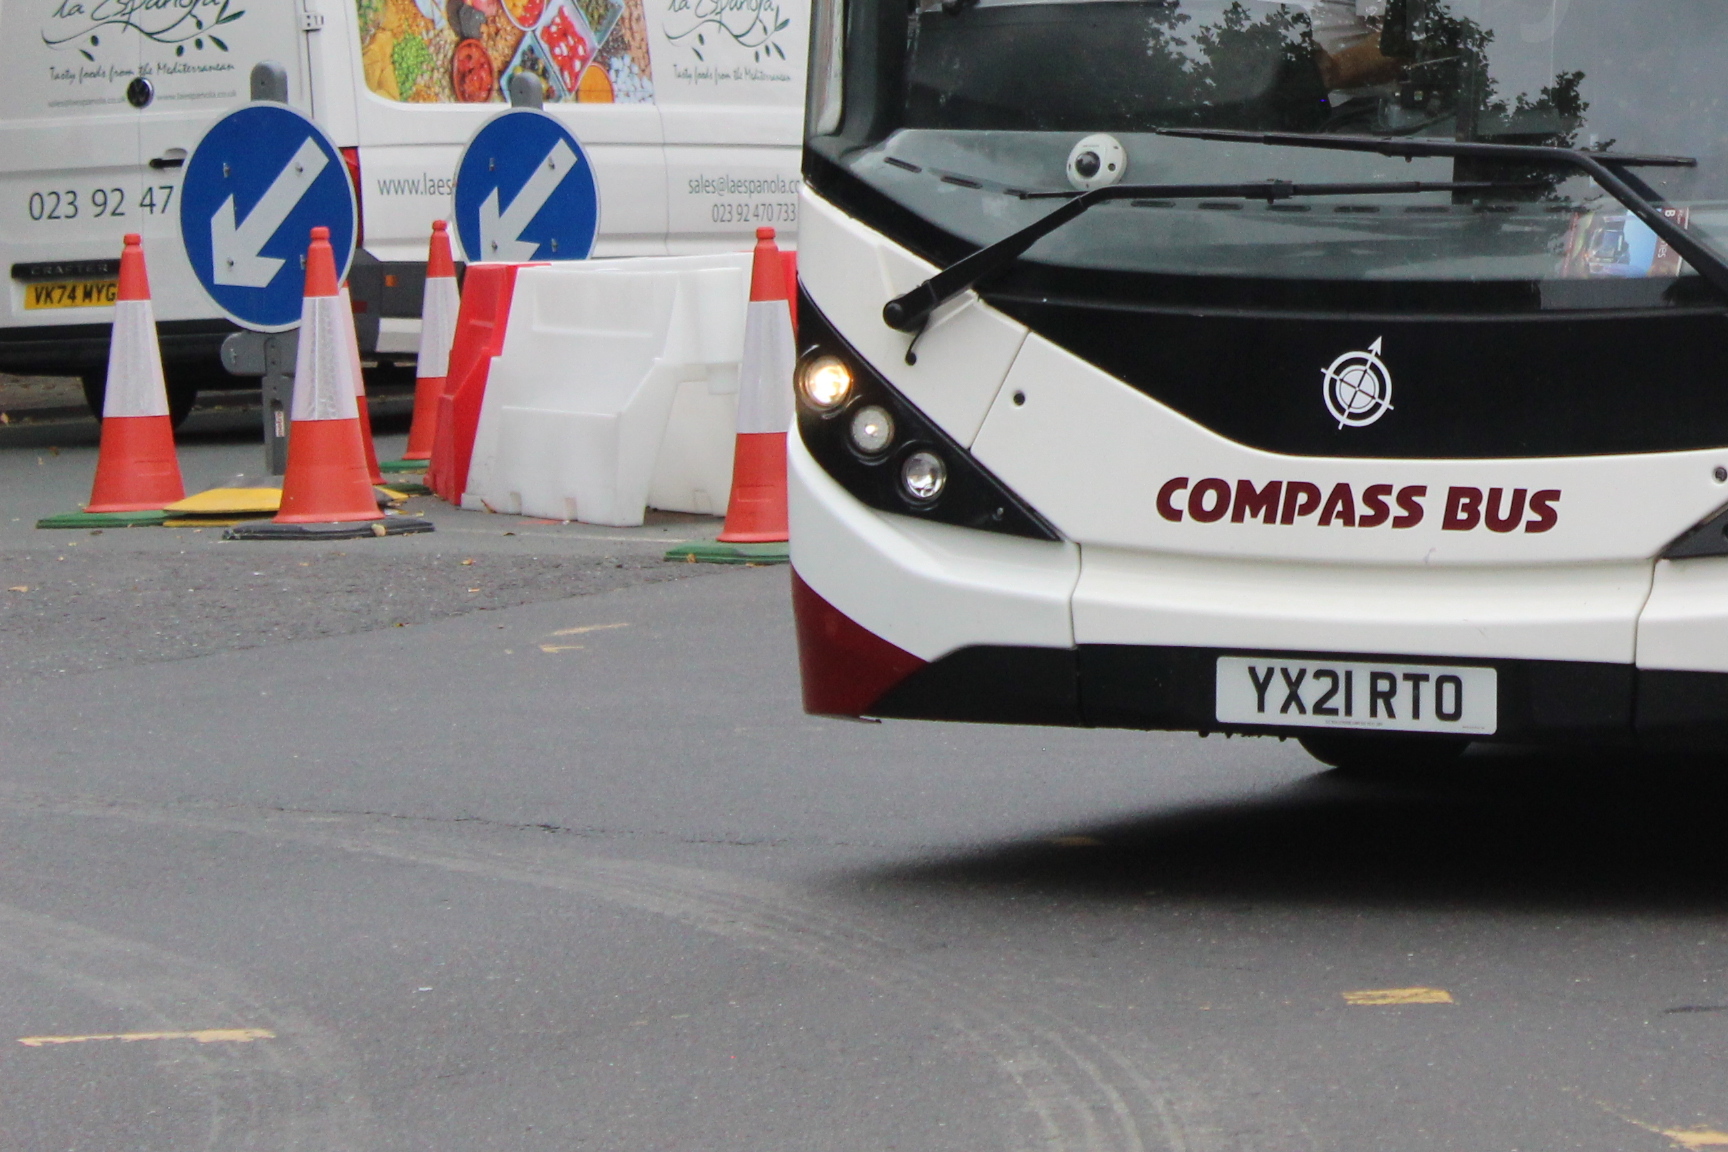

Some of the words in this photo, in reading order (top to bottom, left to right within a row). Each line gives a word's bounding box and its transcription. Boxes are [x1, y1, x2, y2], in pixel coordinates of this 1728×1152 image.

[49, 65, 77, 85] Tasty
[78, 63, 107, 85] foods
[108, 63, 135, 83] from
[156, 58, 236, 76] Mediterranean
[28, 190, 79, 221] 023
[91, 187, 126, 218] 92
[138, 185, 175, 216] 47
[711, 203, 733, 223] 023
[736, 203, 751, 223] 92
[752, 203, 775, 222] 470
[777, 203, 797, 222] 733
[33, 285, 77, 305] VK74
[82, 283, 117, 303] MYG
[1155, 476, 1428, 530] COMPASS
[1441, 485, 1562, 534] BUS
[1247, 665, 1353, 717] YX21
[1368, 673, 1463, 723] RTO
